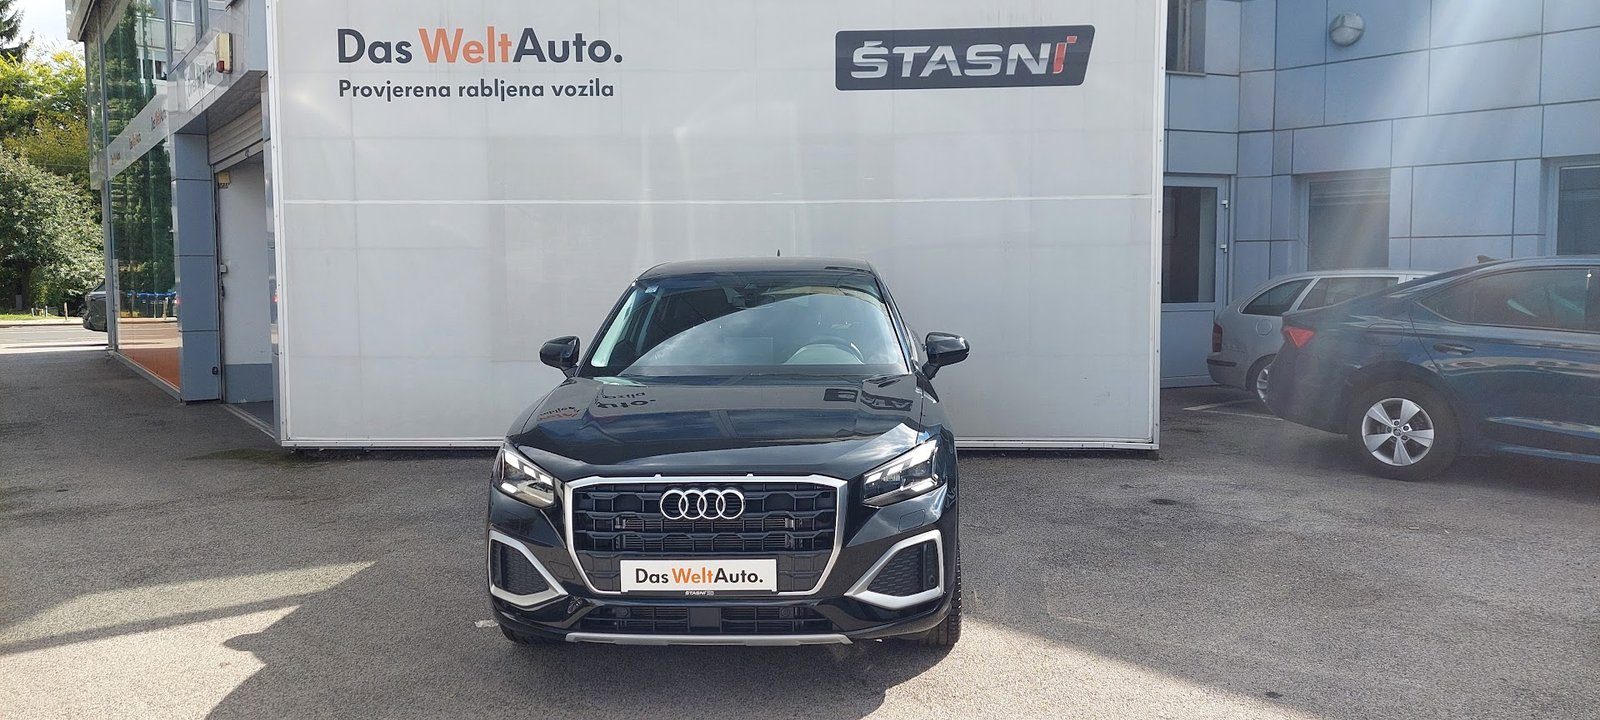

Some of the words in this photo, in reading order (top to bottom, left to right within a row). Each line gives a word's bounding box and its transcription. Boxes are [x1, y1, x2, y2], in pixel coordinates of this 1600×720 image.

[337, 28, 413, 64] Das
[418, 25, 623, 64] WeltAuto.
[338, 79, 451, 102] Provjerena
[458, 78, 544, 102] rabljena
[551, 78, 614, 97] vozila
[635, 568, 669, 584] Das
[671, 567, 764, 584] WeltAuto.
